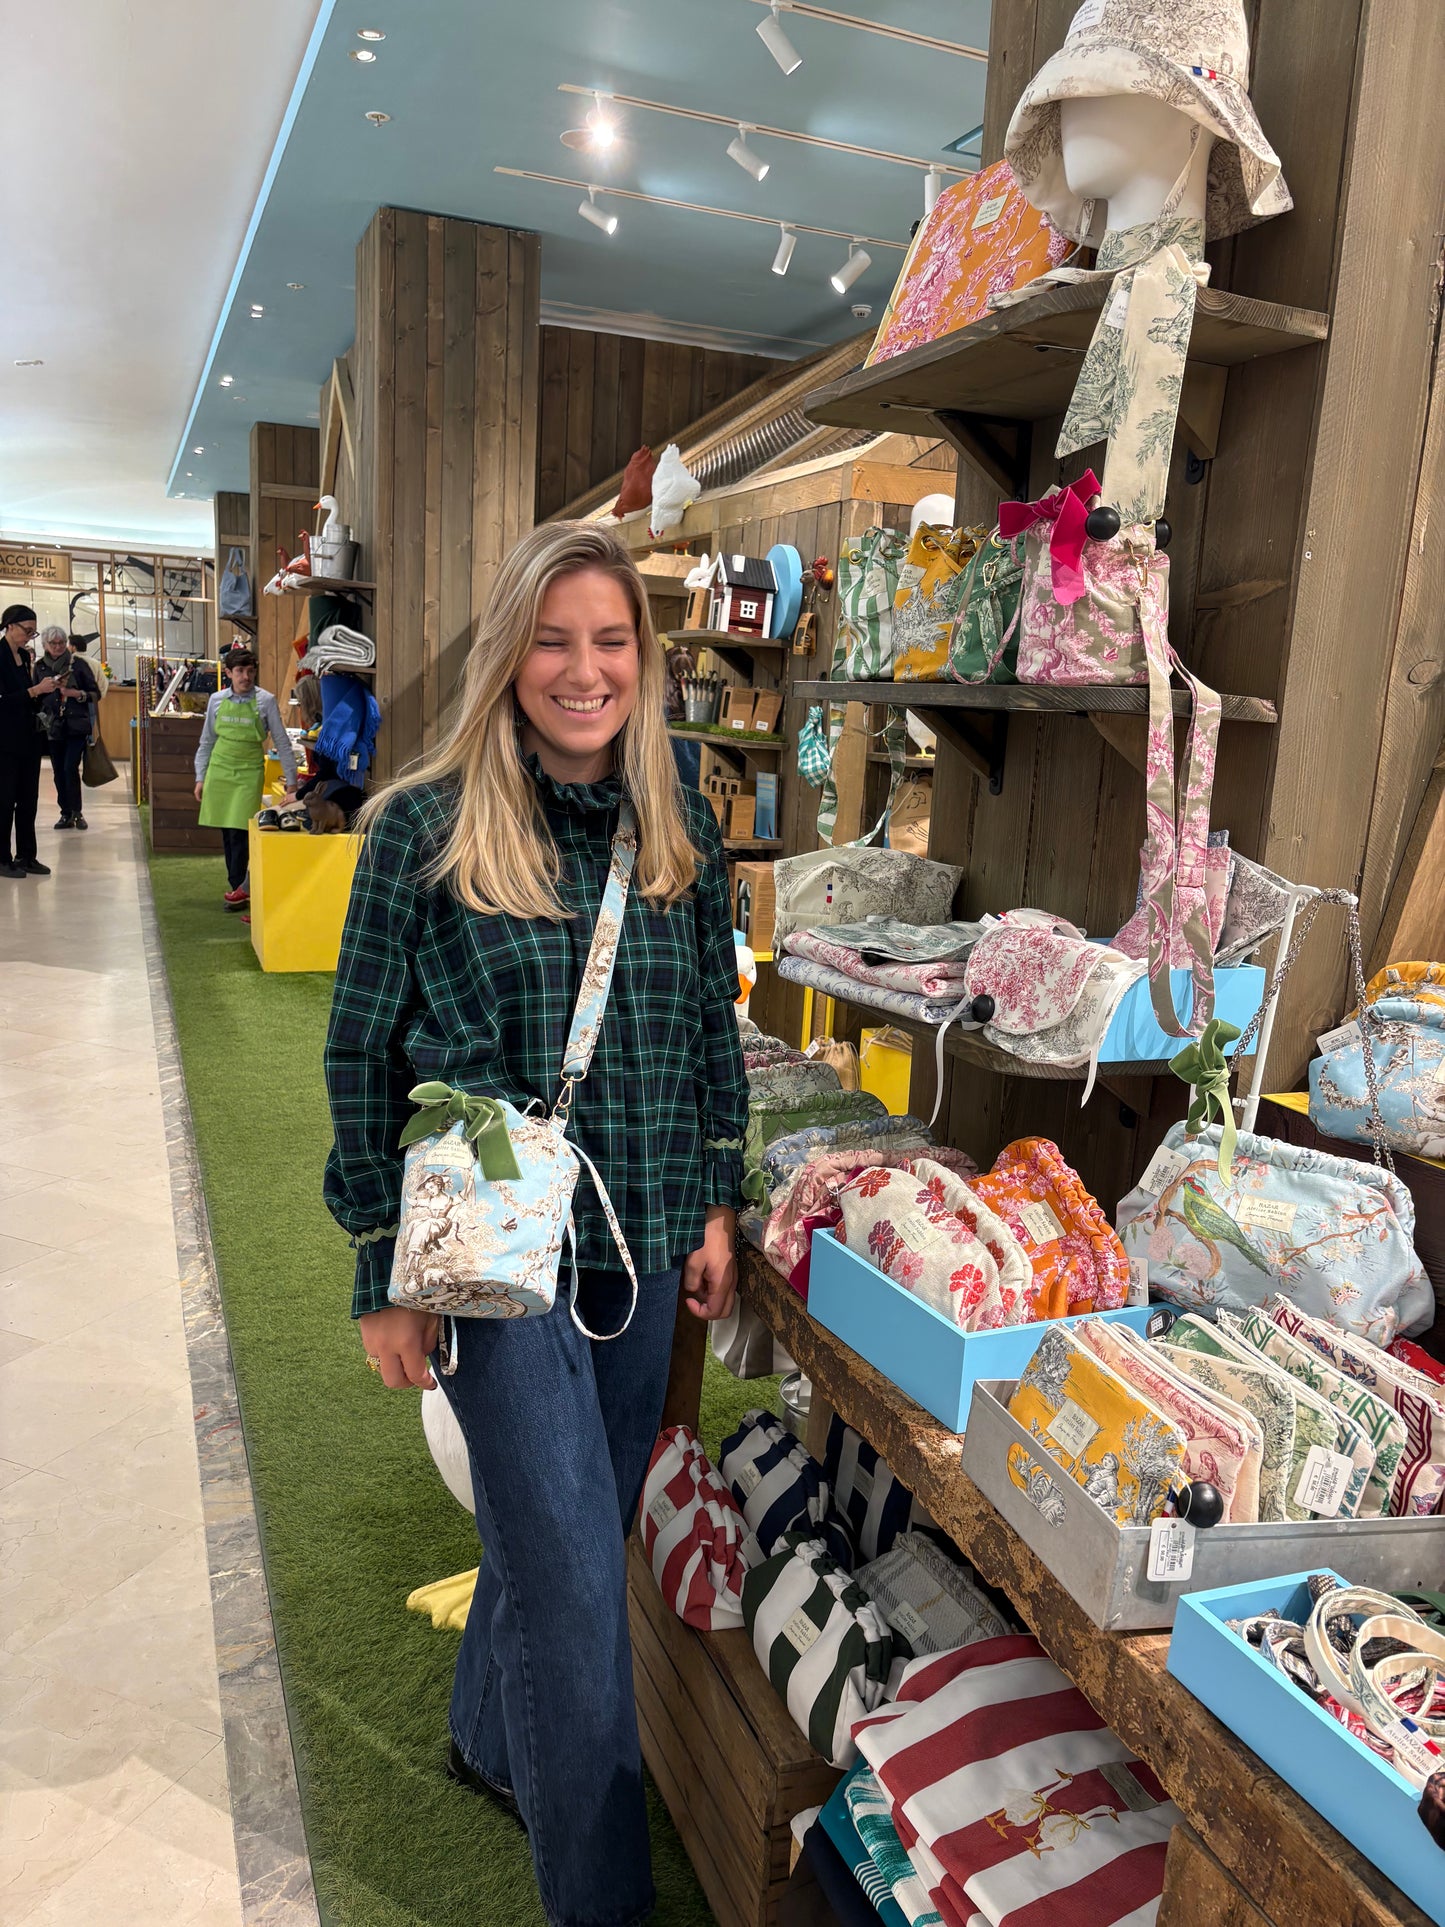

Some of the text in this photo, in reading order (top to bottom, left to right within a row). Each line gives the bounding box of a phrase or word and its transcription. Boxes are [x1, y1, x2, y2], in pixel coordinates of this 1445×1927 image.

[36, 570, 57, 578] DESK
[1385, 1729, 1410, 1750] Atelier
[1402, 1733, 1427, 1757] BAZAR
